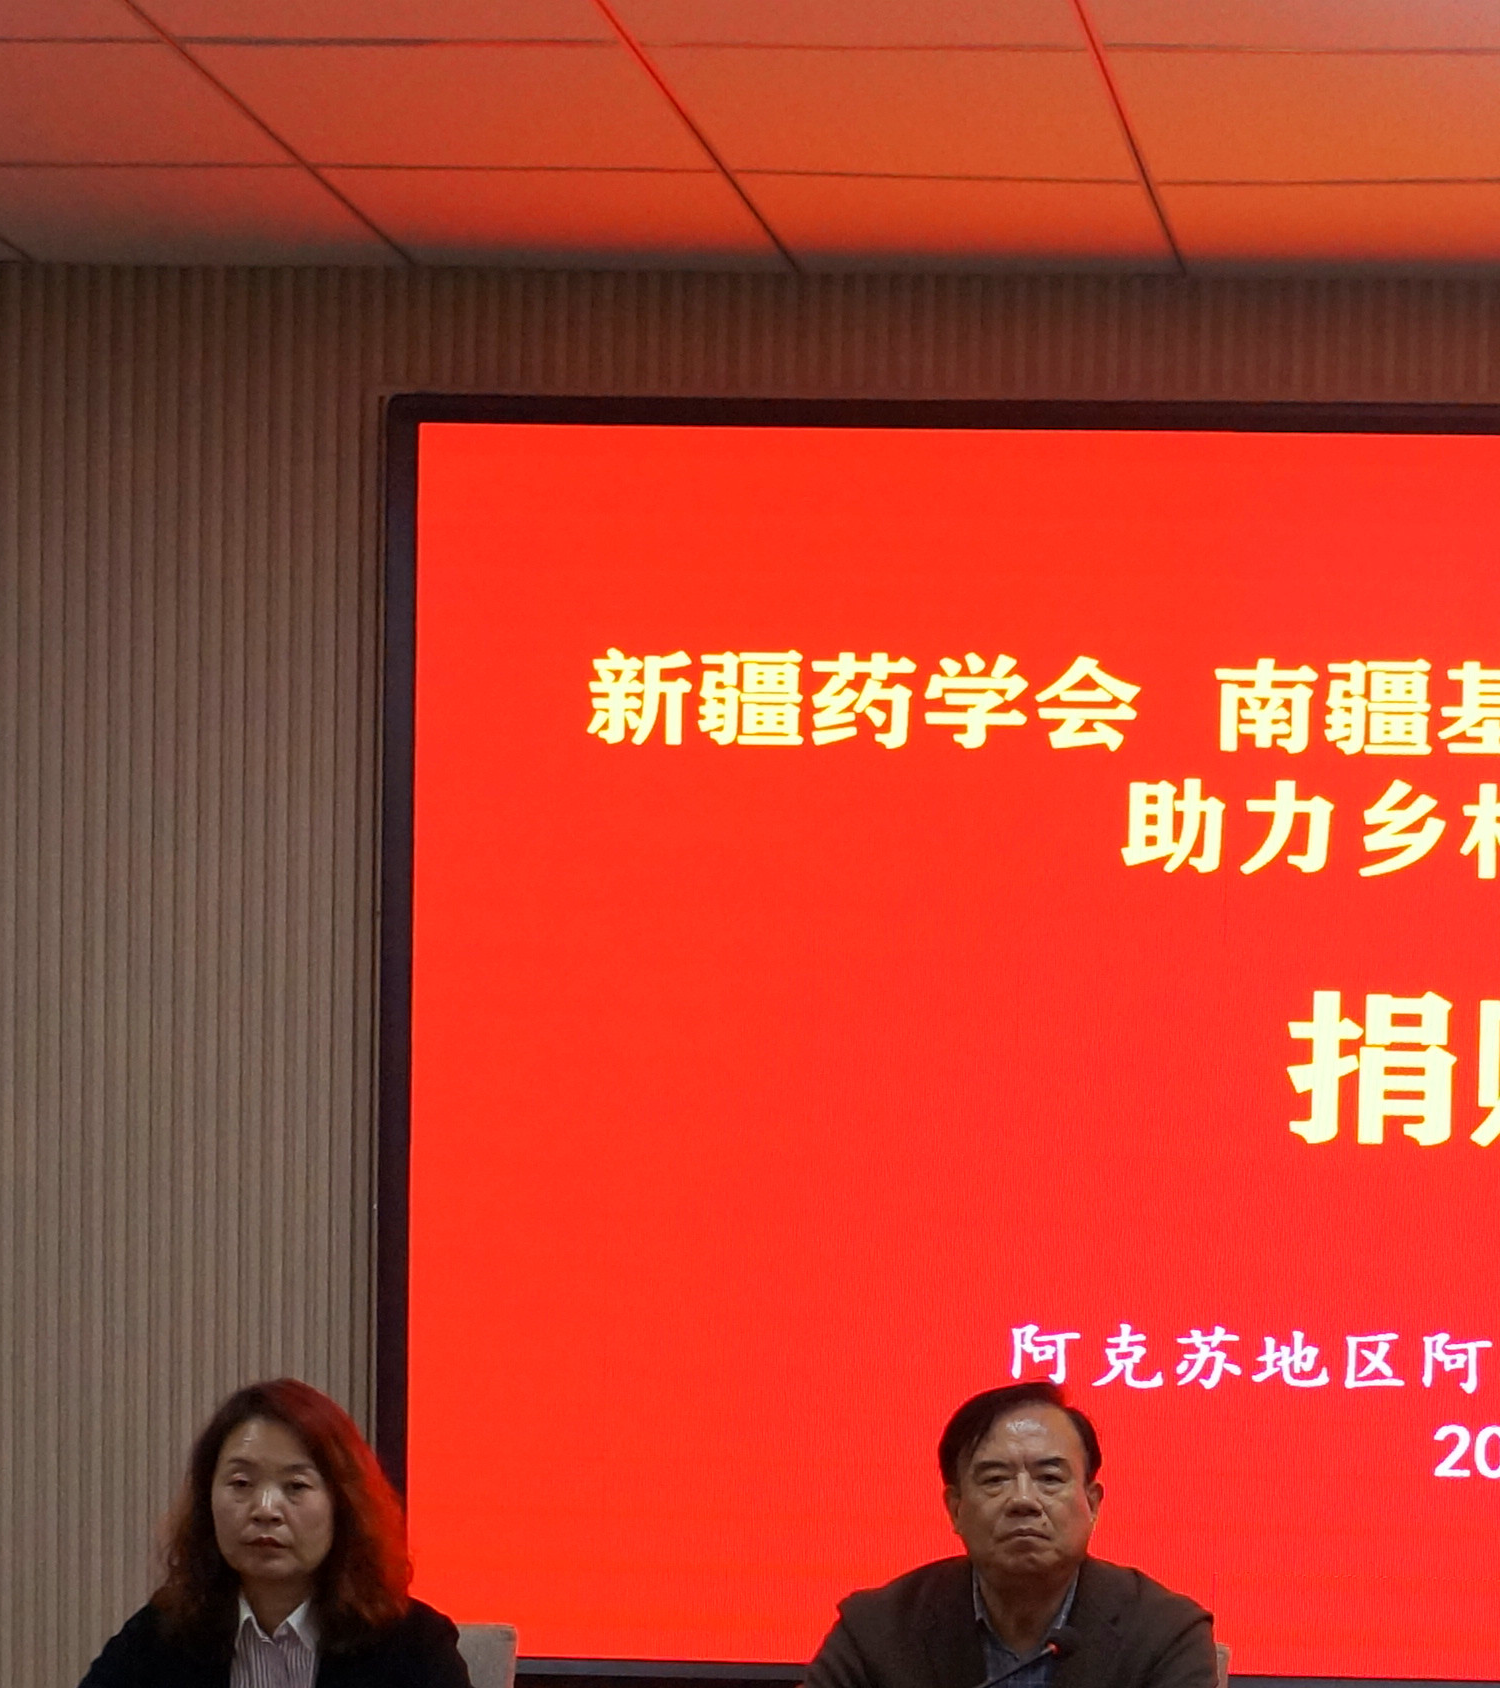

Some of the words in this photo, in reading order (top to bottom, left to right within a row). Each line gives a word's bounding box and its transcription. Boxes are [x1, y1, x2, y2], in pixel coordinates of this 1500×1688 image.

[587, 648, 1142, 751] 新疆药学会
